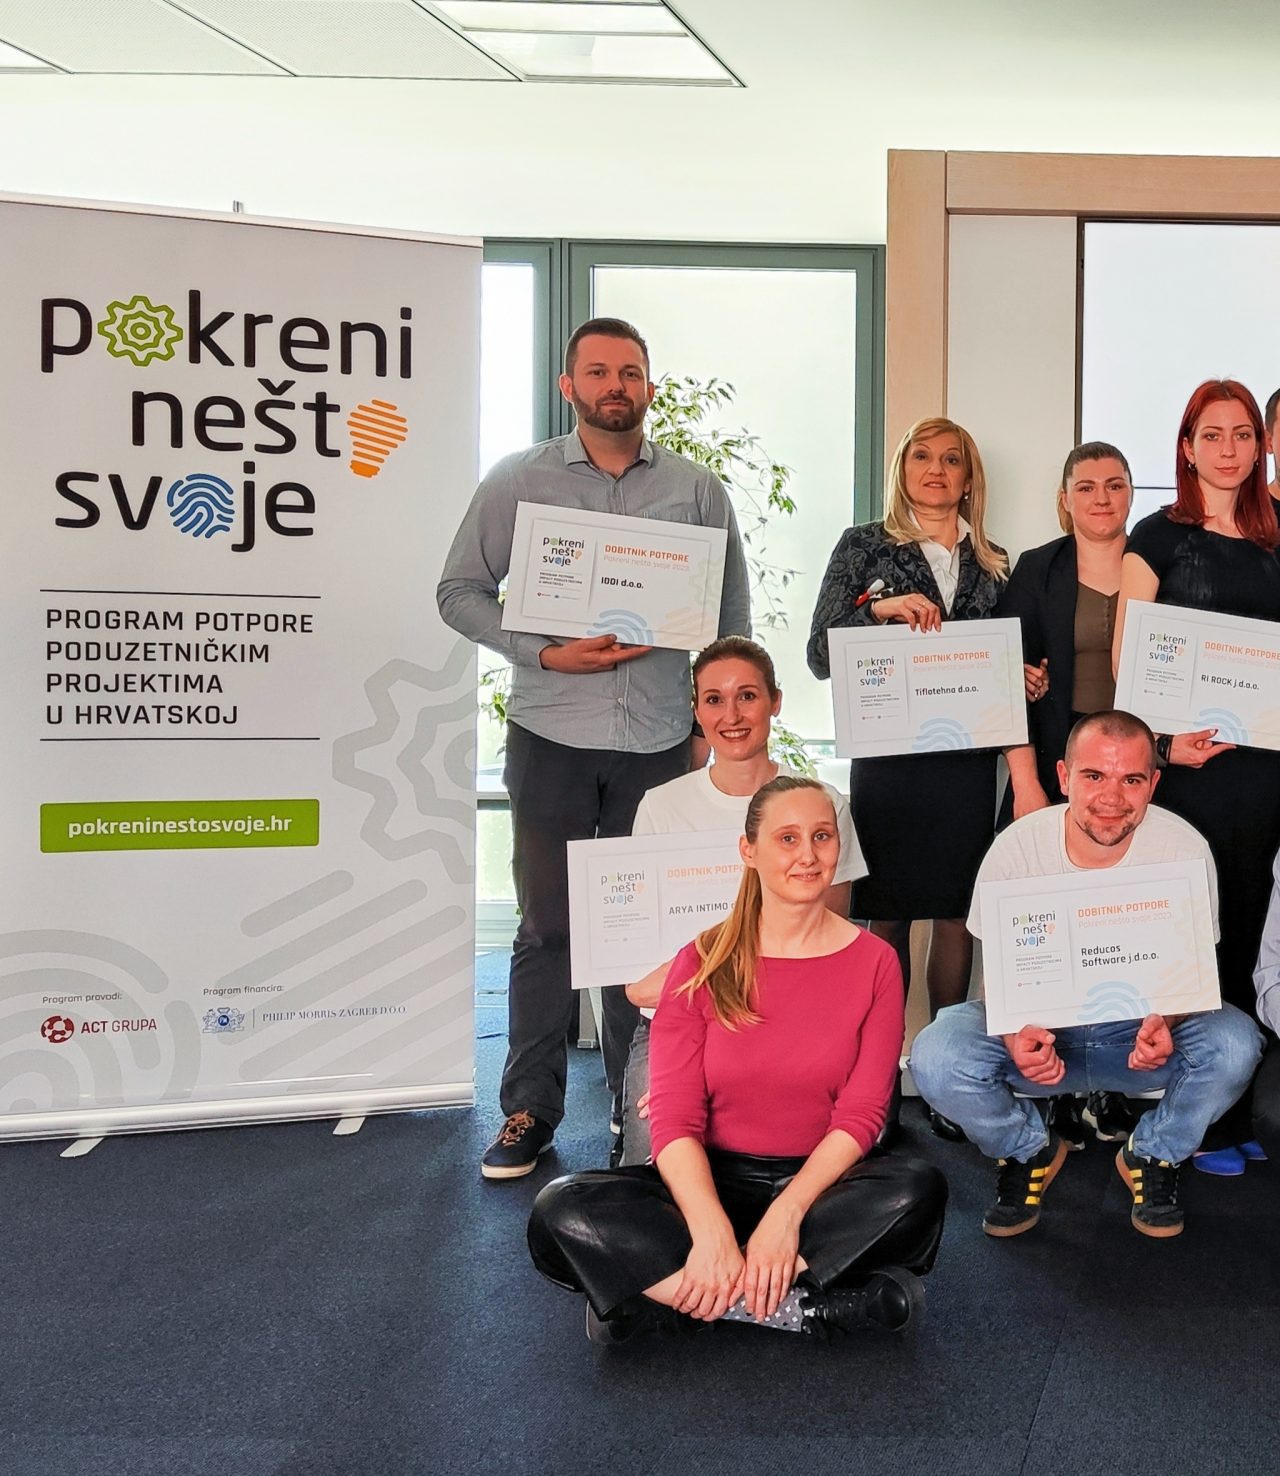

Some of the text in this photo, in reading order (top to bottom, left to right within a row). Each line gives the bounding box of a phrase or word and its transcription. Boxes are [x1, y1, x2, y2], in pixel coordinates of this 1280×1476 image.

[604, 544, 689, 562] DOBITNIK POTPORE
[601, 577, 644, 589] IDDI d.o.o.
[45, 608, 314, 634] PROGRAM POTPORE
[45, 638, 270, 664] PODUZETNIČKIM
[1205, 642, 1243, 655] DOBITNIK
[913, 651, 990, 664] DOBITNIK POTPORE
[45, 672, 223, 695] PROJEKTIMA
[1211, 676, 1232, 686] ROCK
[915, 685, 979, 697] Tiflotehna d.o.o.
[45, 704, 238, 725] U HRVATSKOJ
[67, 814, 293, 839] pokreninestosvoje.hr
[667, 866, 713, 878] DOBITNIK
[669, 905, 694, 915] ARYA
[696, 902, 728, 912] INTIMO
[1078, 900, 1169, 918] DOBITNIK POTPORE
[1081, 944, 1121, 956] Reducos
[1082, 954, 1126, 968] Software
[202, 985, 241, 996] Program
[42, 991, 123, 1004] Program provodi:
[262, 1012, 296, 1022] PHILIP
[299, 1010, 337, 1019] MORRIS
[339, 1007, 378, 1017] ZAGREB
[81, 1019, 157, 1034] ACT GRUPA
